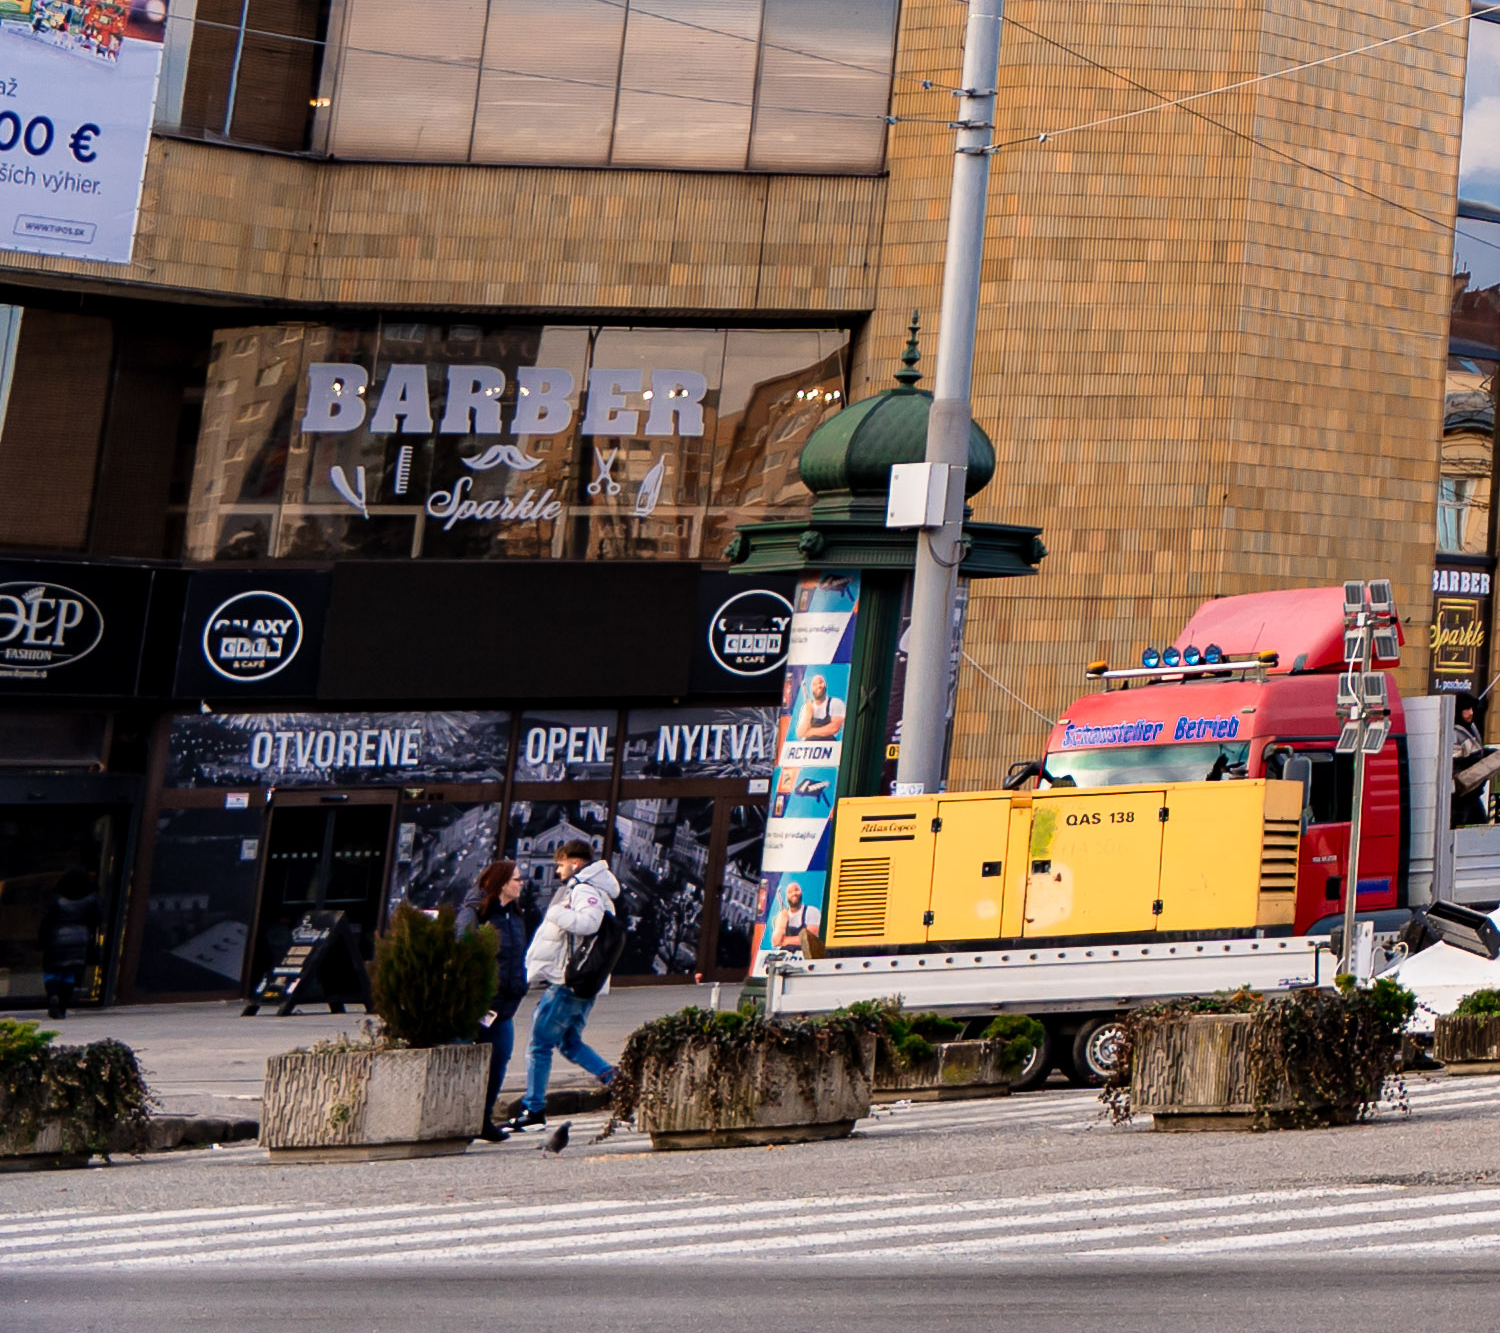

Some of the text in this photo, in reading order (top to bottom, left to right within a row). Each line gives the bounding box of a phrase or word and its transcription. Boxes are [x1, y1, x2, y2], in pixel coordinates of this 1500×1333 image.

[69, 123, 101, 163] €
[42, 170, 101, 195] výhier.
[302, 363, 707, 436] BARBER
[427, 476, 564, 531] Sparkle
[1432, 569, 1491, 595] BARBER
[726, 636, 780, 651] CLUB
[1429, 611, 1485, 653] Sparkle
[5, 648, 53, 661] FASHION
[1173, 714, 1240, 741] Betrieb
[251, 719, 765, 769] OTVORENÉ OPEN NYITVA
[861, 823, 917, 833] Atlas Copco
[1066, 812, 1135, 826] QAS 138
